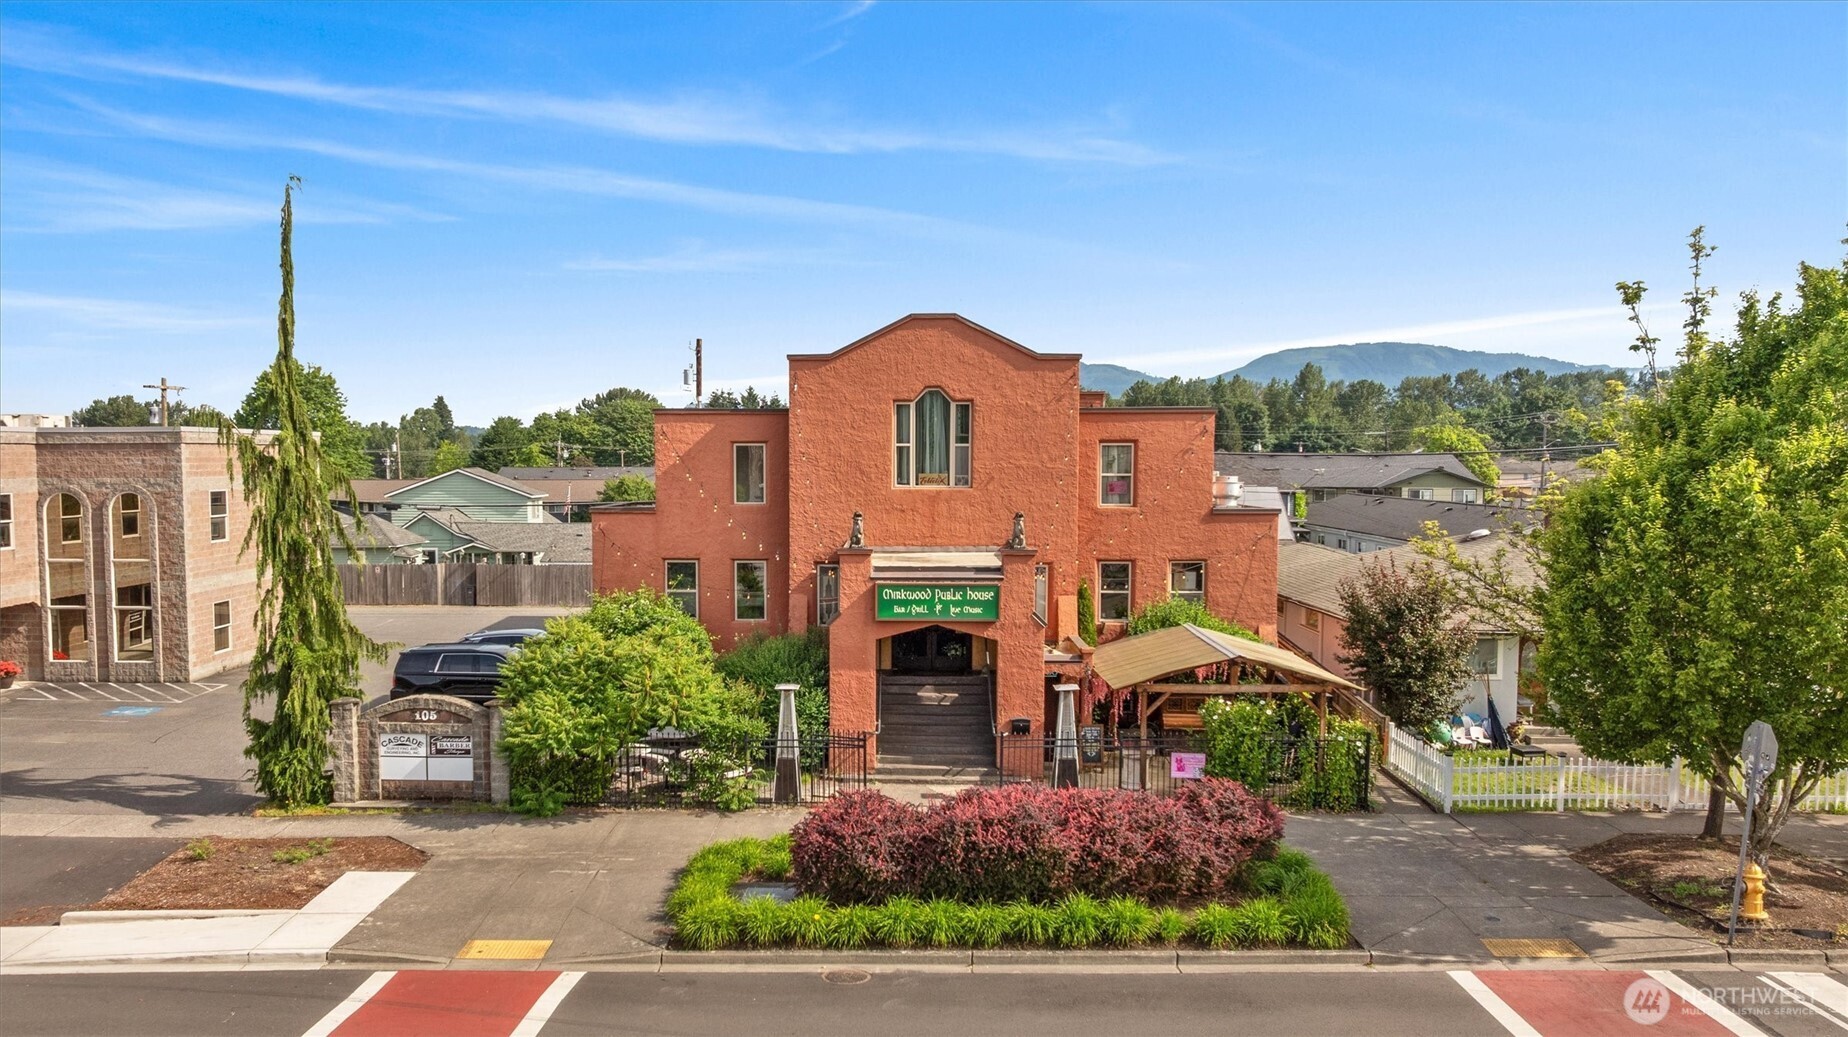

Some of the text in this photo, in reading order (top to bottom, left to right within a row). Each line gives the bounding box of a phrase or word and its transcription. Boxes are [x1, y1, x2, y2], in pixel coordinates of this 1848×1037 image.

[882, 588, 932, 600] Mirkwood
[934, 588, 963, 603] Public
[414, 710, 437, 721] 105
[381, 735, 425, 749] CASCADE
